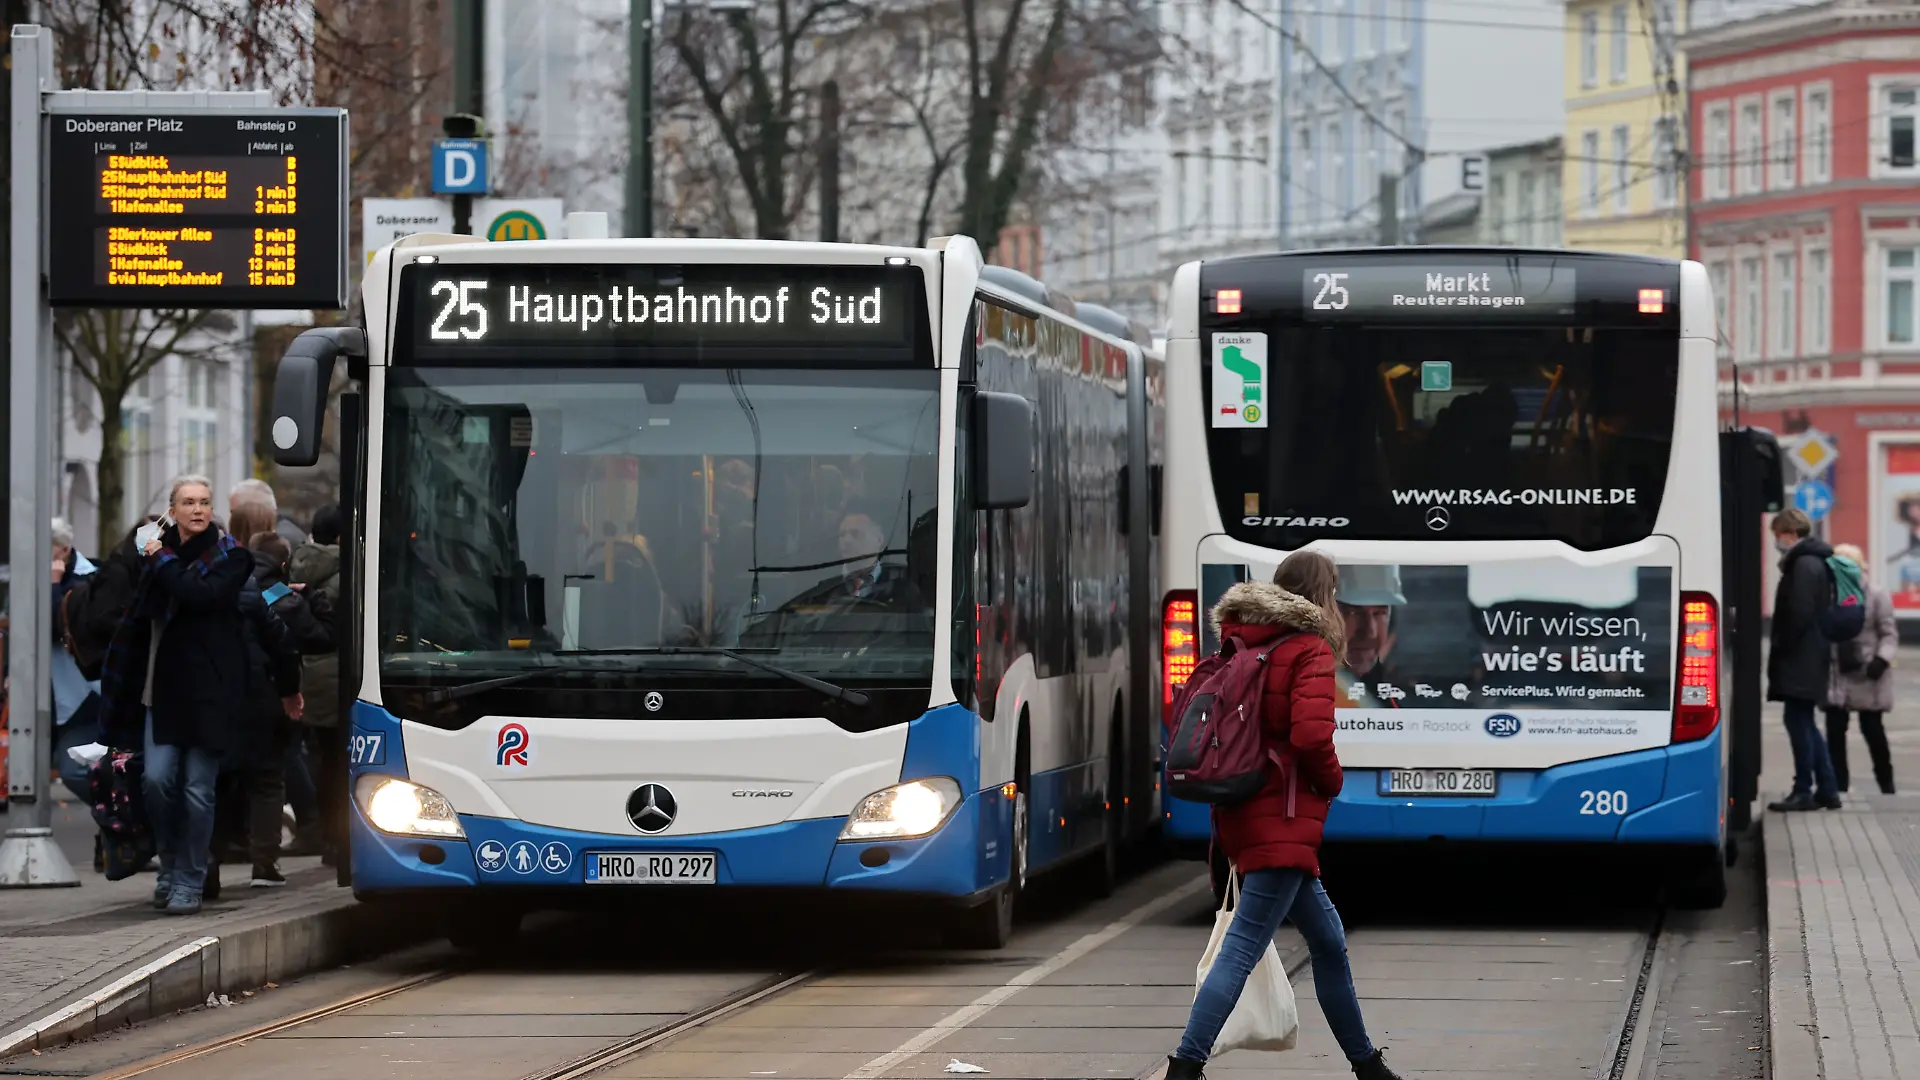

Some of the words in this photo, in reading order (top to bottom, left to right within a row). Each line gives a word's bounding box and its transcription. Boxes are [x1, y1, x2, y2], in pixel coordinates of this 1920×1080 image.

[66, 118, 142, 133] Doberaner
[147, 118, 183, 132] Platz
[237, 120, 286, 133] Bahnsteig
[288, 121, 296, 131] D
[134, 142, 148, 150] Ziel
[252, 142, 278, 150] Abfahrt
[284, 142, 294, 150] ab
[445, 150, 476, 187] D
[1463, 158, 1483, 190] E
[102, 170, 118, 184] 25
[118, 170, 202, 186] Hauptbahnhof
[204, 170, 227, 184] Süd
[287, 171, 296, 184] D
[102, 185, 118, 198] 25
[118, 185, 202, 200] Hauptbahnhof
[204, 185, 227, 199] Süd
[256, 186, 263, 199] 1
[266, 186, 286, 199] min
[287, 186, 296, 199] D
[111, 200, 118, 213] 1
[118, 200, 184, 213] Hafenallee
[255, 200, 264, 214] 3
[266, 200, 286, 214] min
[376, 215, 439, 225] Doberaner
[108, 228, 117, 241] 3
[181, 228, 213, 241] Allee
[254, 228, 263, 241] 8
[266, 228, 286, 241] min
[287, 228, 296, 241] D
[254, 243, 263, 256] 8
[266, 243, 286, 256] min
[110, 257, 117, 270] 1
[117, 257, 183, 270] Hafenallee
[248, 257, 263, 271] 13
[266, 257, 286, 271] min
[117, 271, 136, 285] via
[138, 271, 222, 287] Hauptbahnhof
[248, 272, 263, 285] 15
[266, 272, 286, 285] min
[287, 272, 296, 285] D
[1425, 272, 1491, 292] Markt
[1313, 273, 1349, 310] 25
[1392, 294, 1526, 308] Reutershagen
[429, 279, 489, 341] 25
[508, 285, 789, 332] Hauptbahnhof
[810, 286, 882, 325] Süd
[1218, 336, 1252, 345] danke
[1392, 488, 1637, 505] WWW.RSAG-ONLINE.DE
[1242, 516, 1350, 527] CITARO
[1483, 610, 1533, 637] Wir
[1541, 610, 1647, 642] wissen,
[1482, 646, 1561, 673] wie's
[1571, 646, 1645, 673] läuft
[1481, 685, 1554, 698] ServicePlus.
[1556, 685, 1585, 698] Wird
[1586, 685, 1645, 700] gemacht.
[1423, 720, 1471, 732] Rostock
[1489, 718, 1517, 731] FSN
[1528, 725, 1638, 736] www.fsn-autohaus.de
[350, 735, 381, 763] 297
[1391, 771, 1423, 790] HRO
[1436, 771, 1457, 790] RO
[1462, 772, 1493, 790] 280
[732, 789, 793, 798] CITARO
[1579, 791, 1628, 815] 280
[599, 857, 635, 877] HRO
[649, 857, 673, 877] RO
[678, 857, 713, 877] 297
